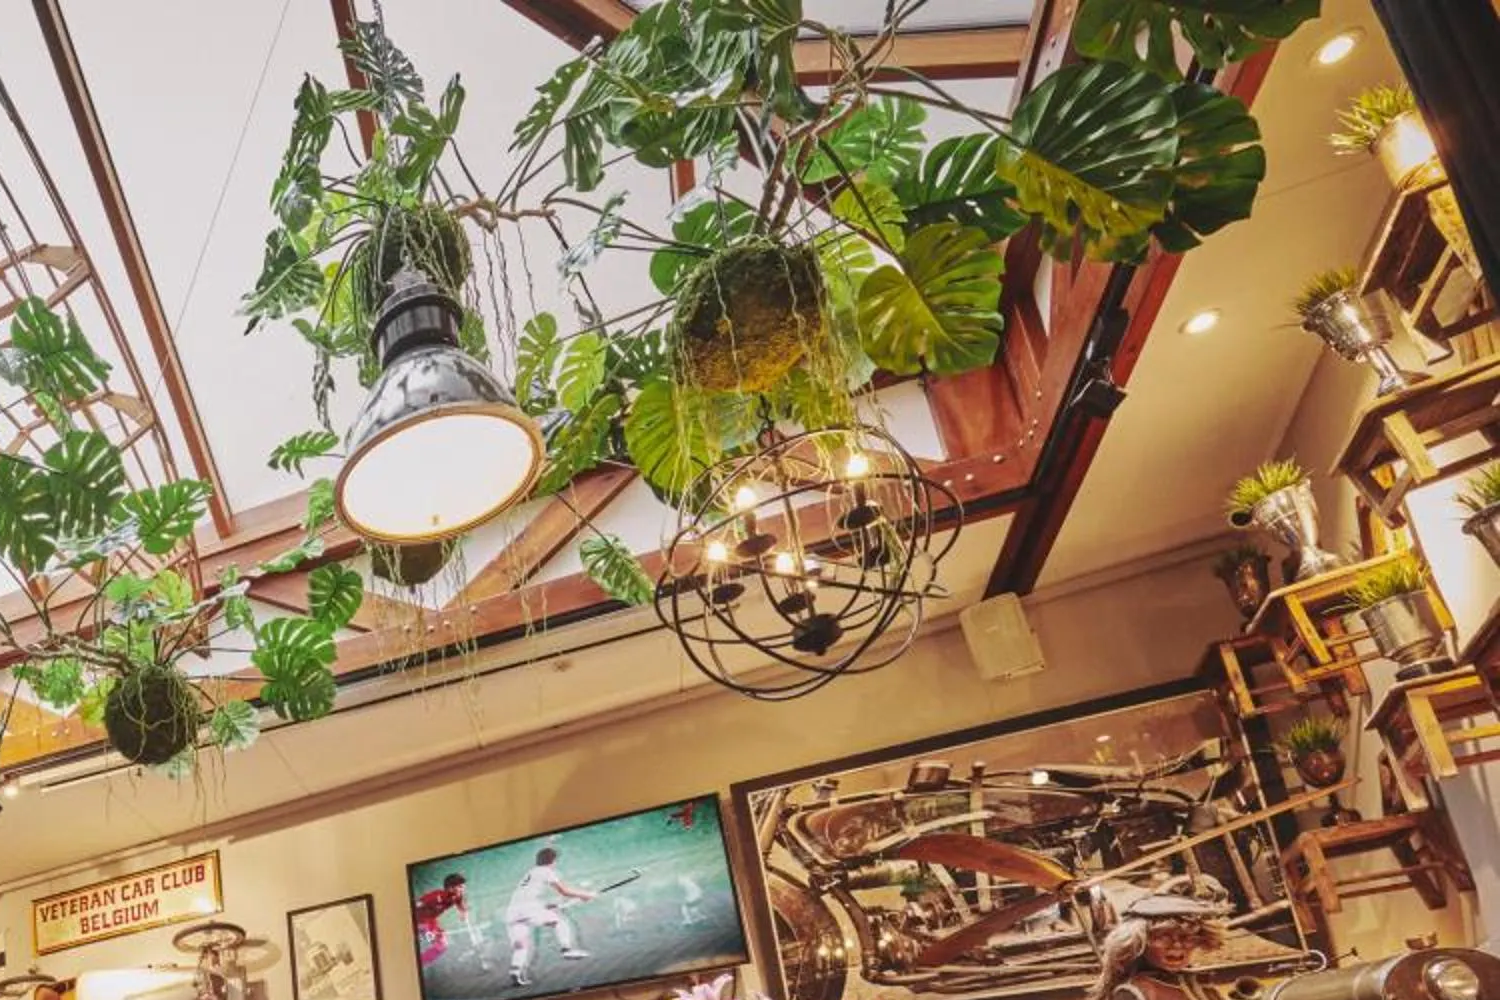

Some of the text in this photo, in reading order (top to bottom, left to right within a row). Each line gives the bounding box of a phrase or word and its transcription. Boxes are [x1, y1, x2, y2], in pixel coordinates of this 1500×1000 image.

[39, 864, 206, 923] VETERAN CAR CLUB
[79, 899, 160, 935] BELGIUM
